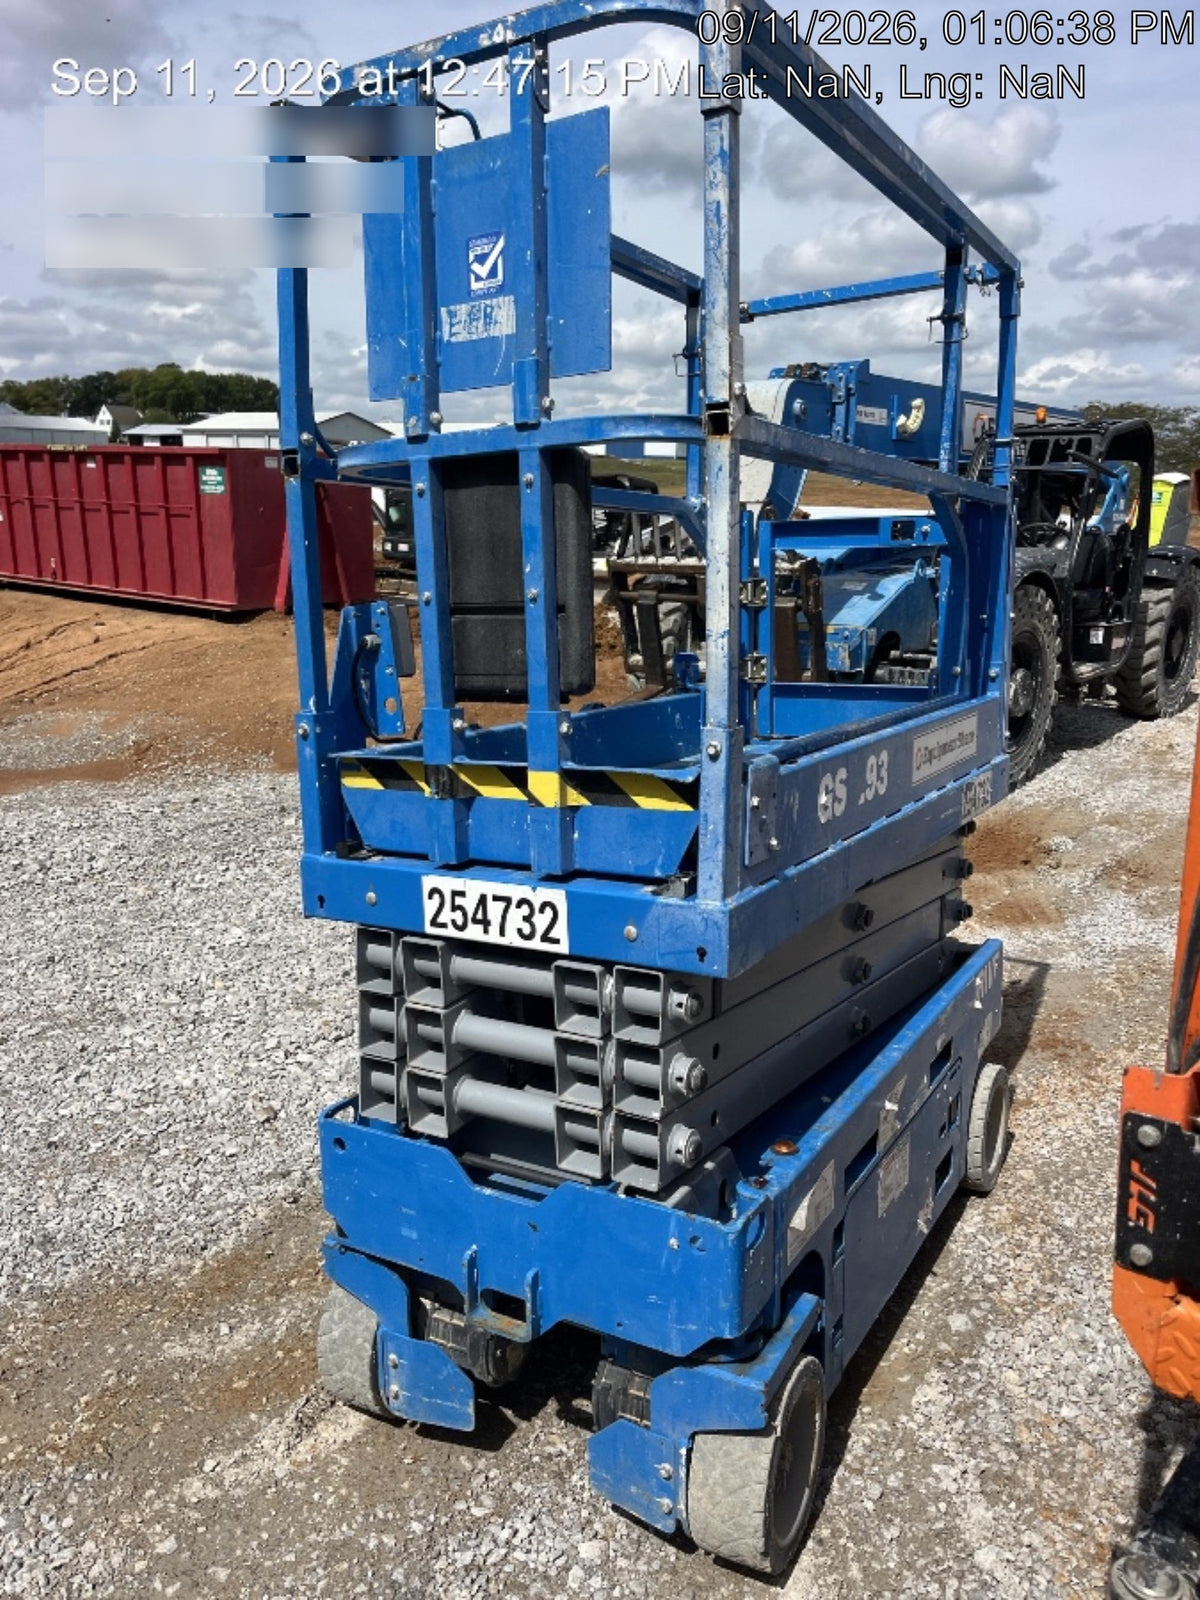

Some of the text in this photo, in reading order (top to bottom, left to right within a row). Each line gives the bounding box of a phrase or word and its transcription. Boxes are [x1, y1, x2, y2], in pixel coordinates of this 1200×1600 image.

[817, 767, 848, 824] GS
[428, 886, 561, 945] 254732
[1127, 1159, 1158, 1234] JLG
